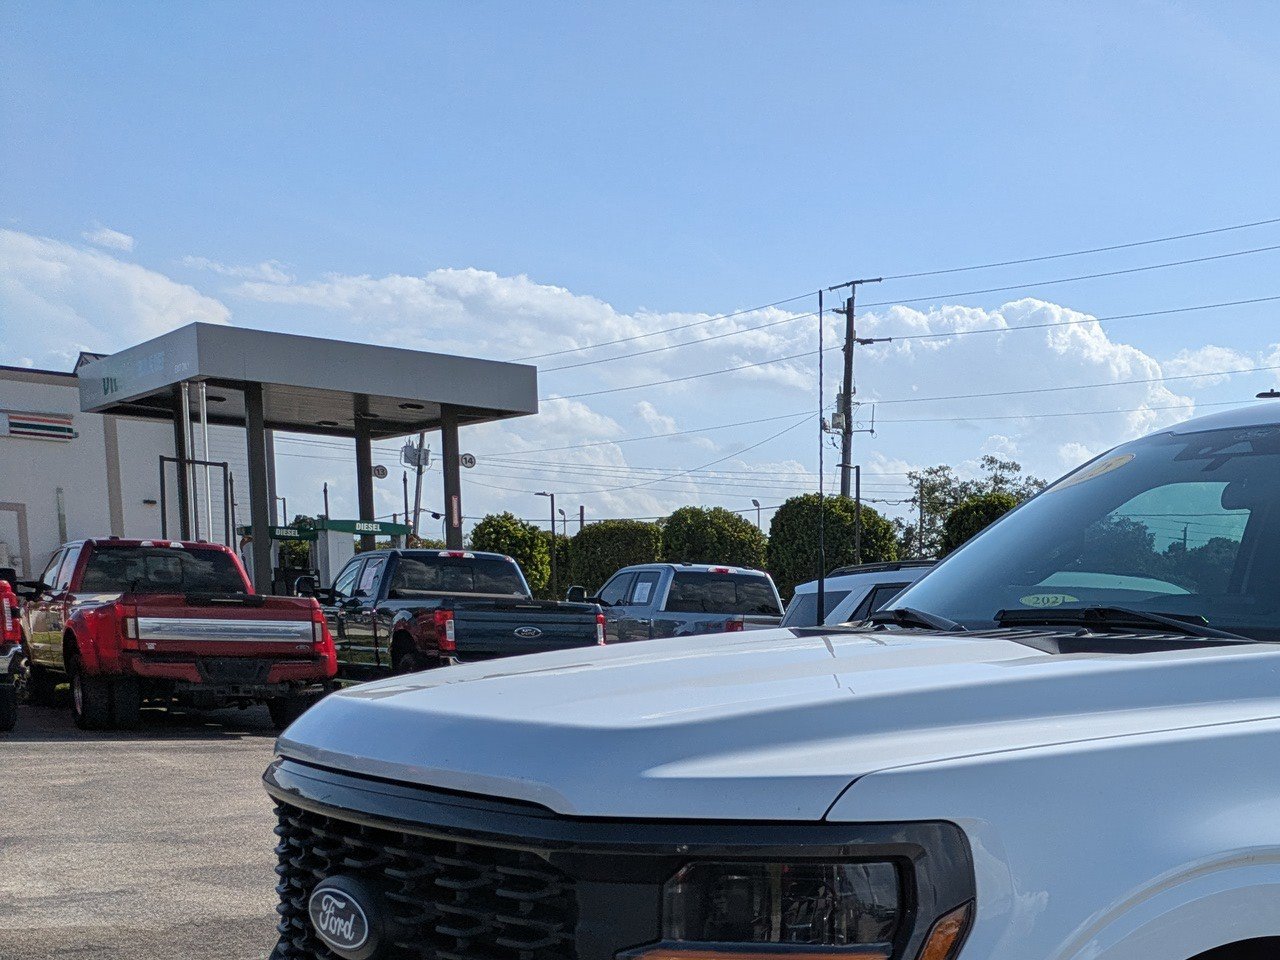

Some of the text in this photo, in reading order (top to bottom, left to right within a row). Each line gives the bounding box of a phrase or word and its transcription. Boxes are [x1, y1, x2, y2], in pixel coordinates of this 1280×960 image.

[463, 456, 474, 466] 14
[376, 467, 386, 476] 13
[355, 522, 382, 532] DIESEL
[275, 528, 300, 537] DIESEL
[319, 894, 356, 941] Ford
